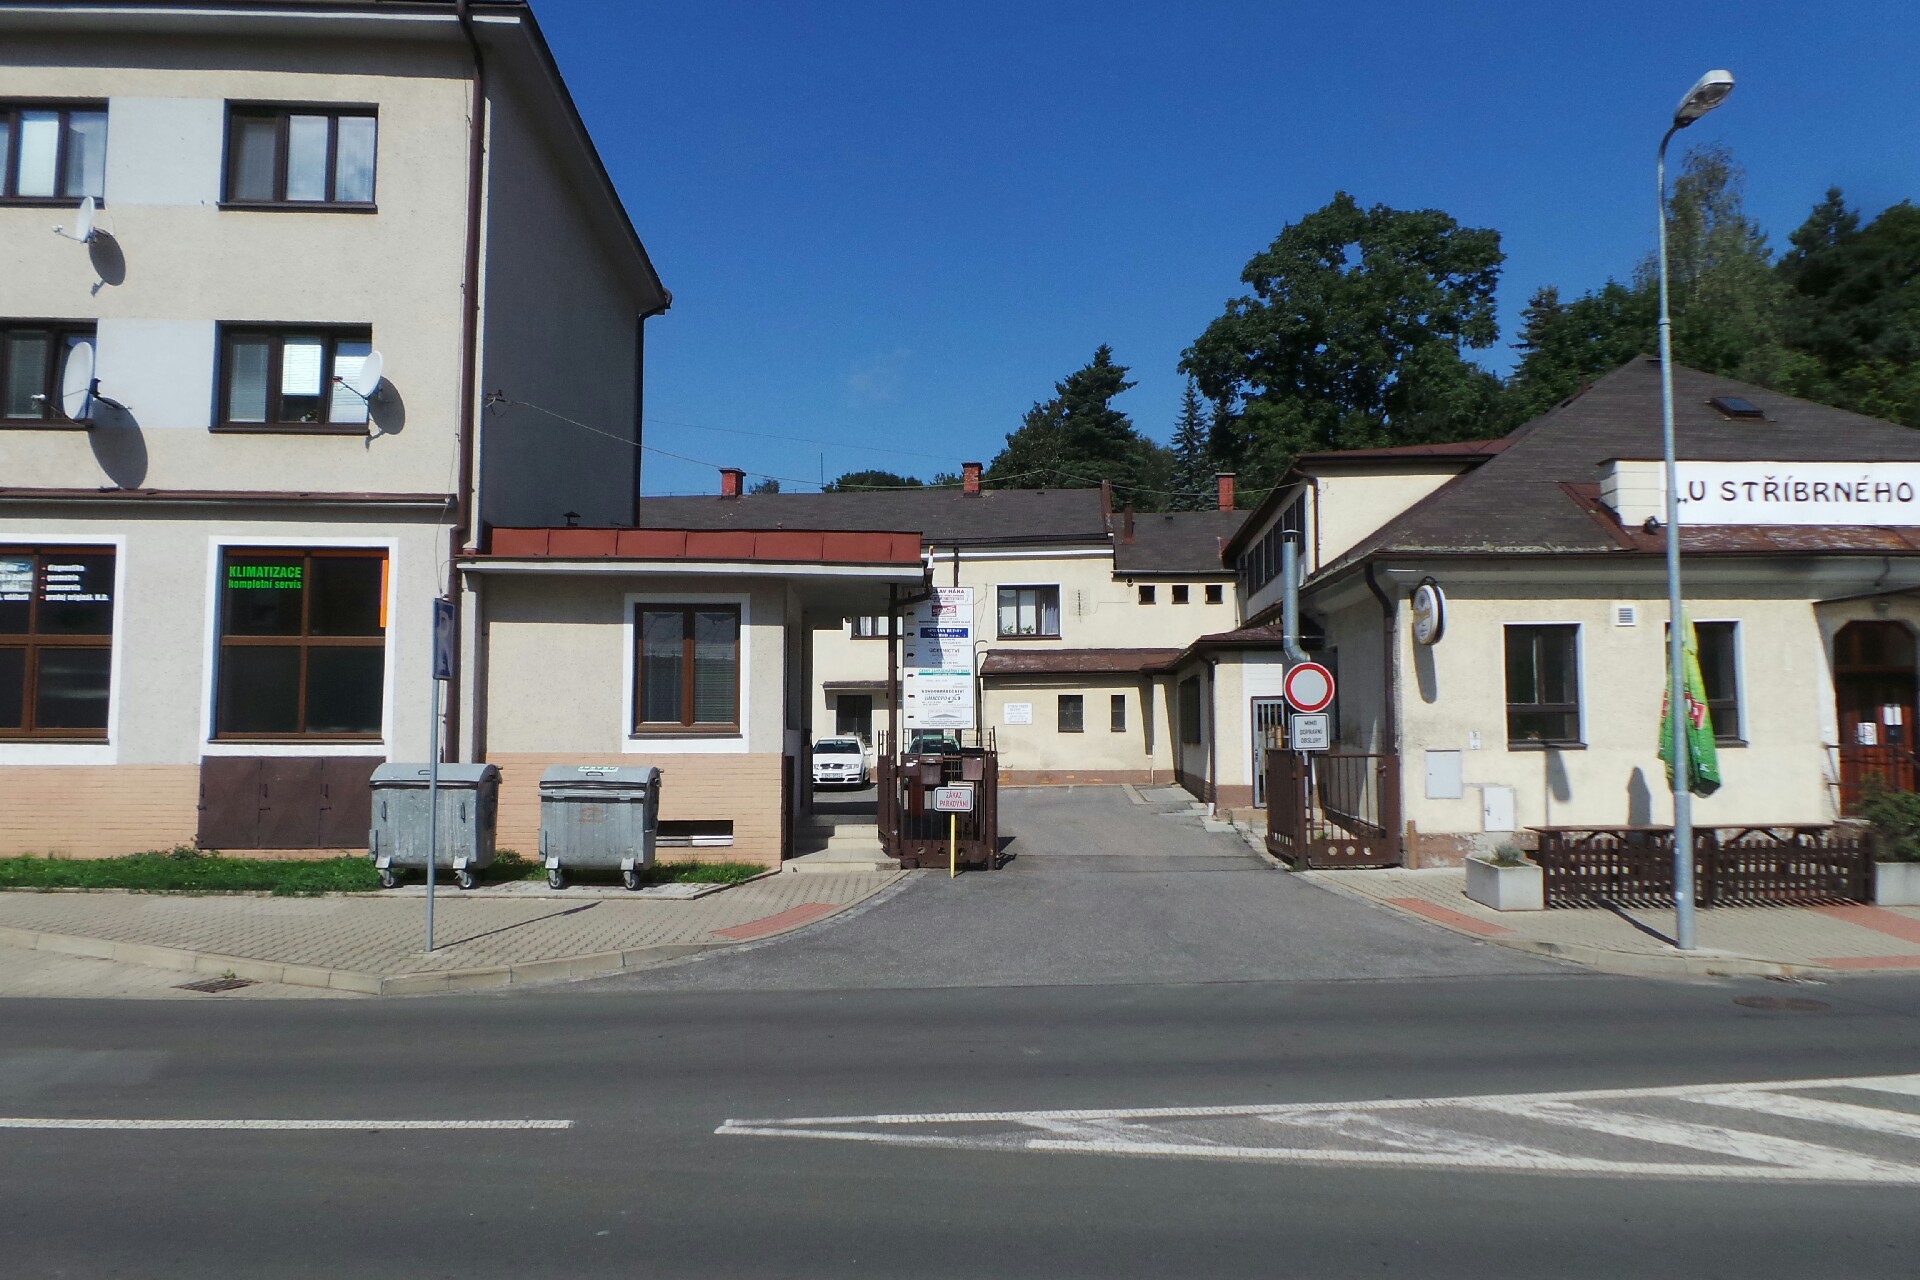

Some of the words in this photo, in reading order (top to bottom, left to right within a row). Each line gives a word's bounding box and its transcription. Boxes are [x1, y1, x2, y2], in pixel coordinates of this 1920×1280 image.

[1720, 475, 1914, 503] STŘÍBRNÉHO
[229, 566, 302, 578] KLIMATIZACE
[228, 579, 273, 589] kompletní
[274, 580, 302, 588] servis
[945, 790, 962, 798] ZÁKAZ
[939, 798, 969, 808] PARKOVÁNÍ
